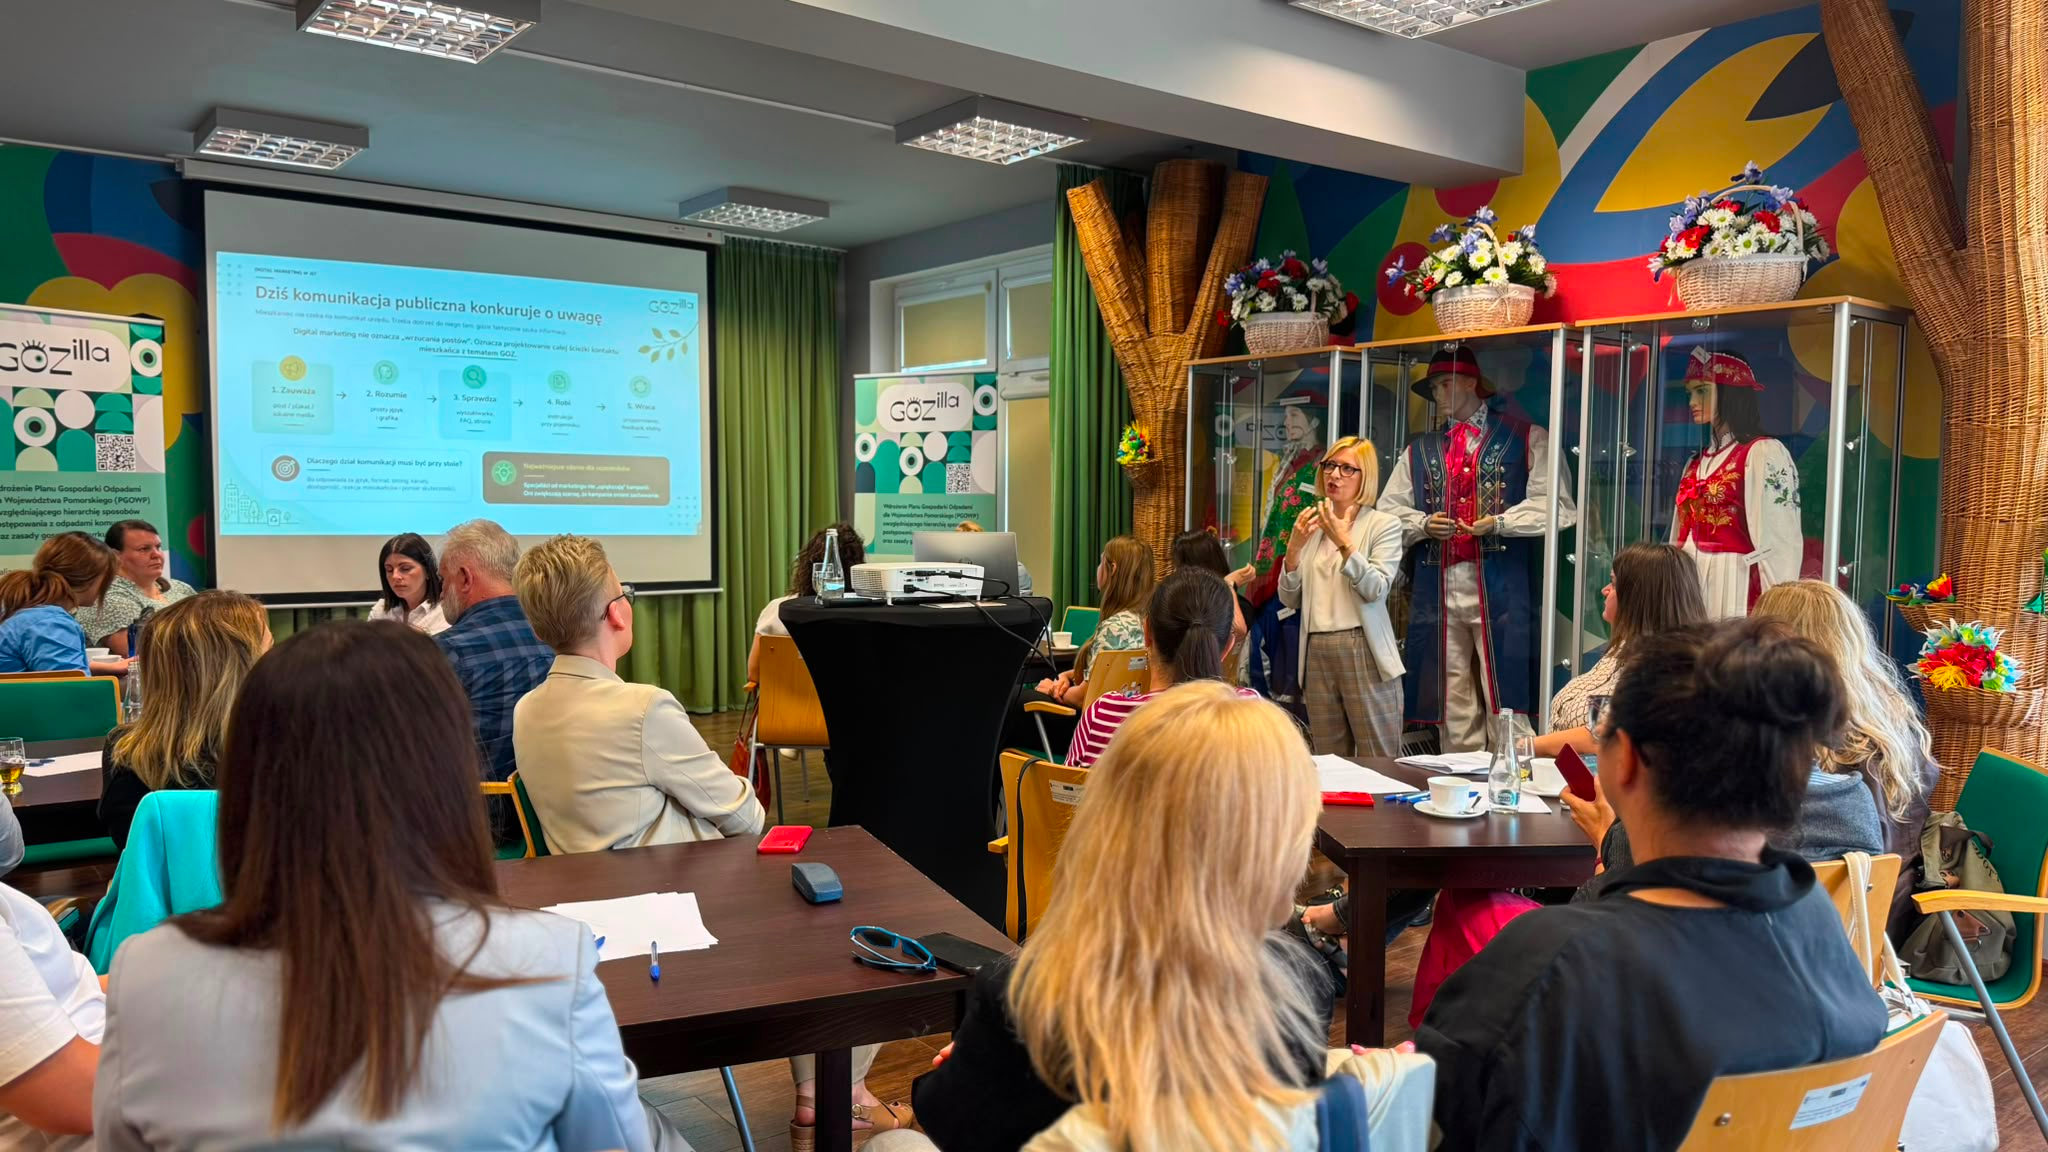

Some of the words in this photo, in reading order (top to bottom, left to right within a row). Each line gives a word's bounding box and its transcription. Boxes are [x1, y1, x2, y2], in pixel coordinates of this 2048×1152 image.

[256, 286, 288, 300] Dziś
[294, 288, 391, 309] komunikacja
[396, 297, 466, 312] publiczna
[471, 300, 541, 320] konkuruje
[545, 309, 553, 319] o
[558, 311, 602, 326] uwagę
[294, 328, 318, 336] Digital
[320, 329, 356, 339] marketing
[474, 338, 502, 346] Oznacza
[0, 339, 109, 376] GOZilla
[375, 391, 407, 399] Rozumie
[462, 394, 497, 404] Sprawdza
[890, 391, 959, 422] GOZilla
[307, 457, 338, 466] Dlaczego
[357, 459, 396, 467] komunikacji
[58, 485, 101, 493] Gospodarki
[103, 485, 142, 493] Odpadami
[4, 496, 61, 506] Województwa
[63, 497, 113, 506] Pomorskiego
[115, 496, 151, 506] (PGOWP)
[64, 508, 100, 516] hierarchię
[102, 508, 140, 517] sposobów
[56, 520, 93, 528] odpadami
[12, 533, 38, 541] zasady
